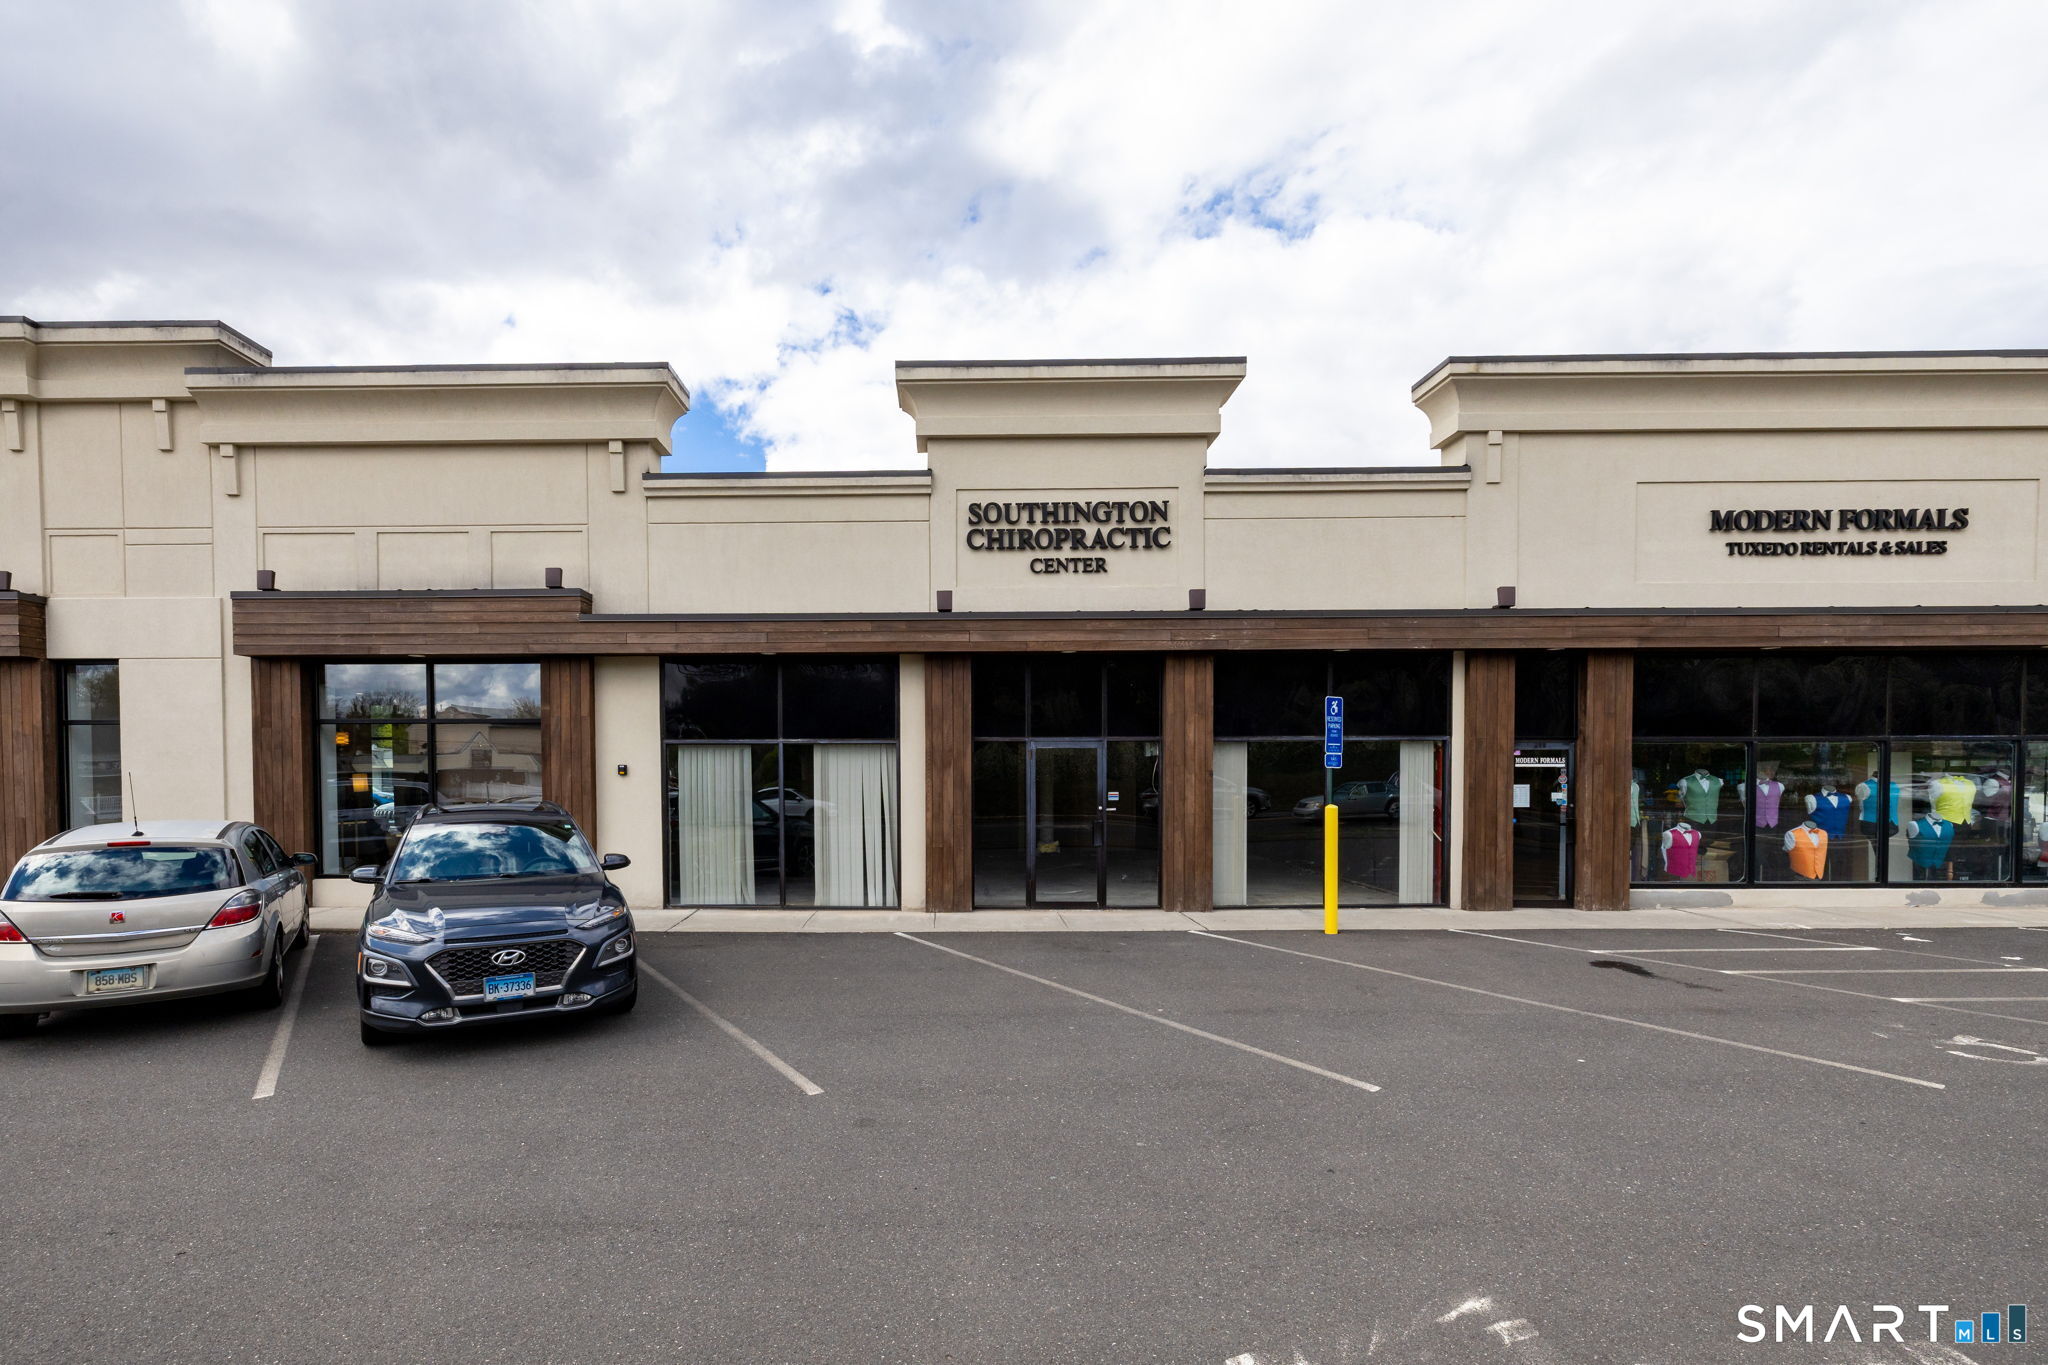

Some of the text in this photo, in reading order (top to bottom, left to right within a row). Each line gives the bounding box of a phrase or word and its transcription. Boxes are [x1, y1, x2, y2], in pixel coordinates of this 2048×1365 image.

[967, 500, 1170, 525] SOUTHINGTON
[1708, 507, 1970, 533] MODERN FORMALS
[966, 526, 1172, 551] CHIROPRACTIC
[1725, 540, 1948, 556] TUXEDO RENTALS & SALES
[1029, 557, 1108, 575] CENTER
